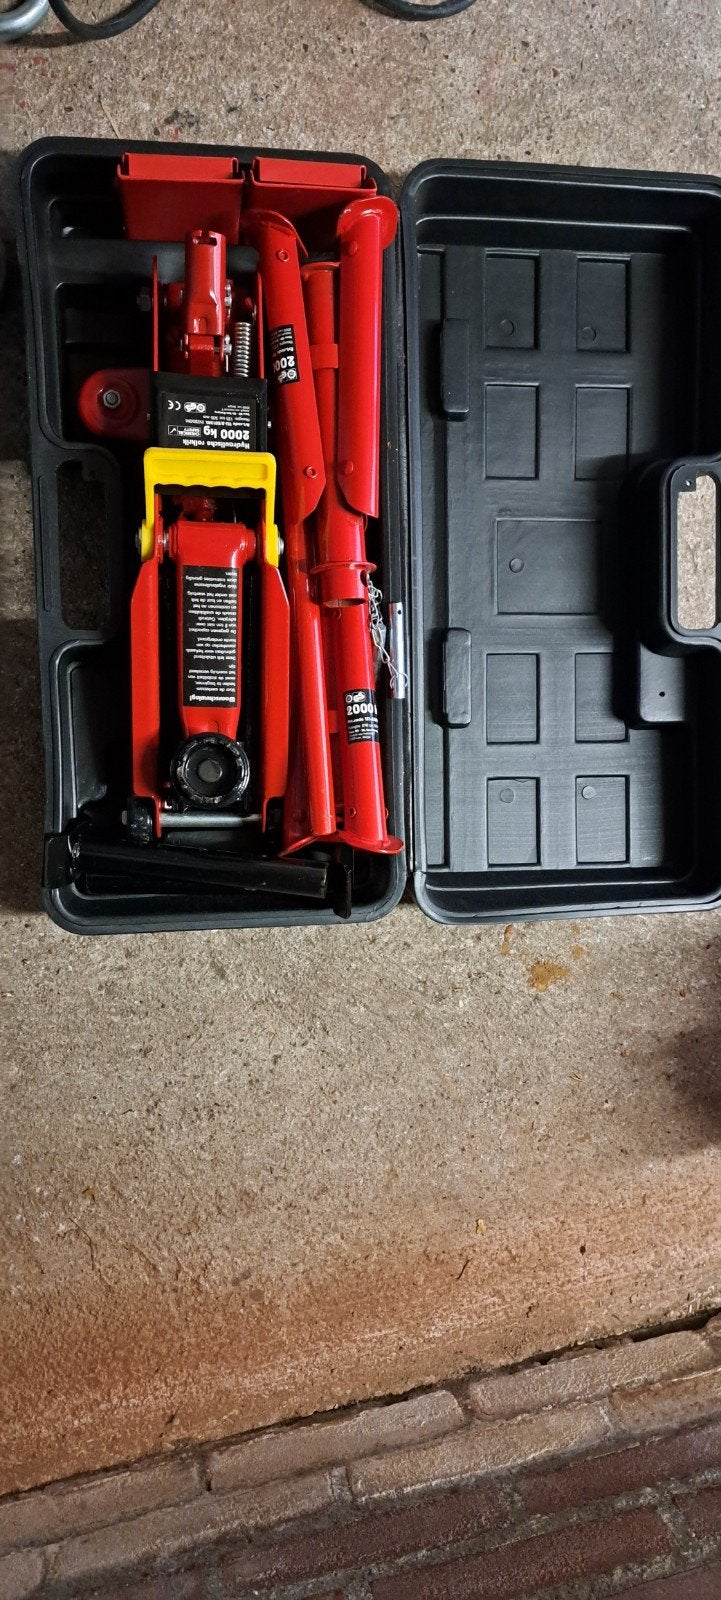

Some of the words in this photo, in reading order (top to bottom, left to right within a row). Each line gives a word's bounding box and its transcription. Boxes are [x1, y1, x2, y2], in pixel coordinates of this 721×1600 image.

[273, 356, 295, 372] 200
[204, 426, 217, 438] kg
[221, 429, 250, 440] 2000
[207, 441, 250, 449] Hydraulische
[347, 703, 373, 715] 2000
